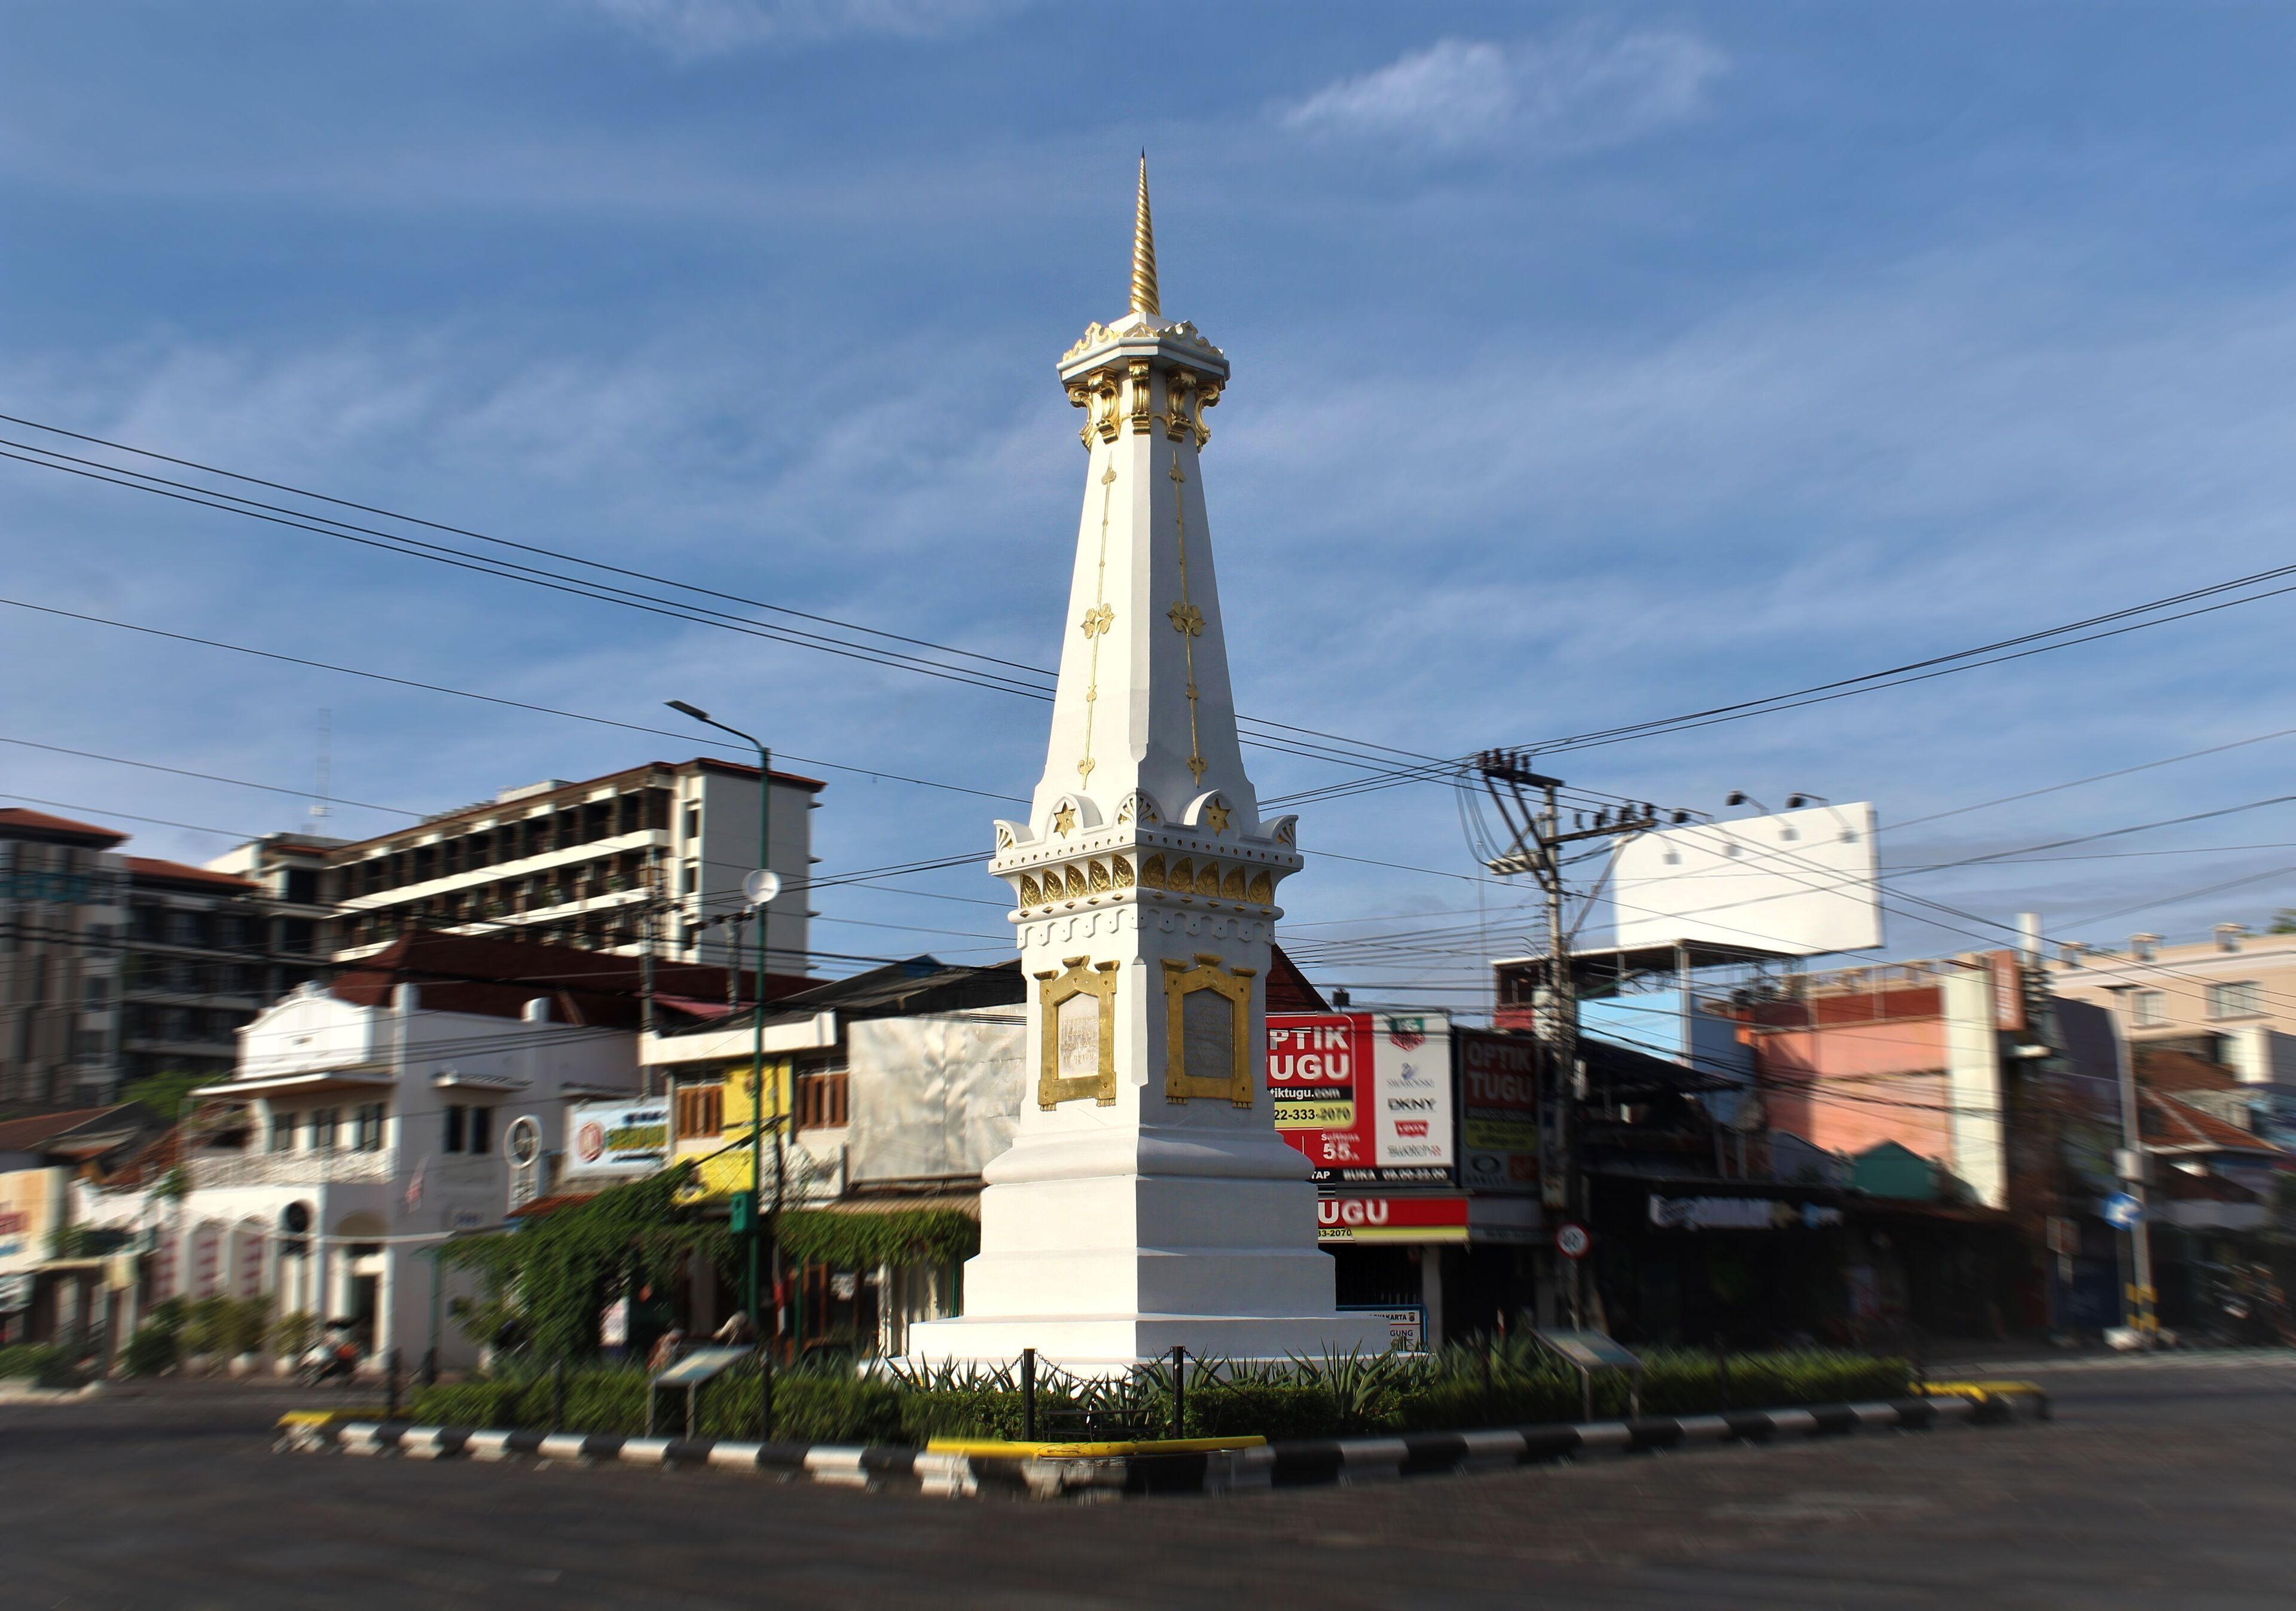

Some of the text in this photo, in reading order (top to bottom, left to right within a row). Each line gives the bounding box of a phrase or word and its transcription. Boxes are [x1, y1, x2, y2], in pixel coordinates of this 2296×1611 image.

[1266, 1054, 1349, 1080] UGU
[1467, 1071, 1533, 1103] TUGU
[1388, 1098, 1436, 1111] DKNY
[1318, 1199, 1388, 1225] UGU
